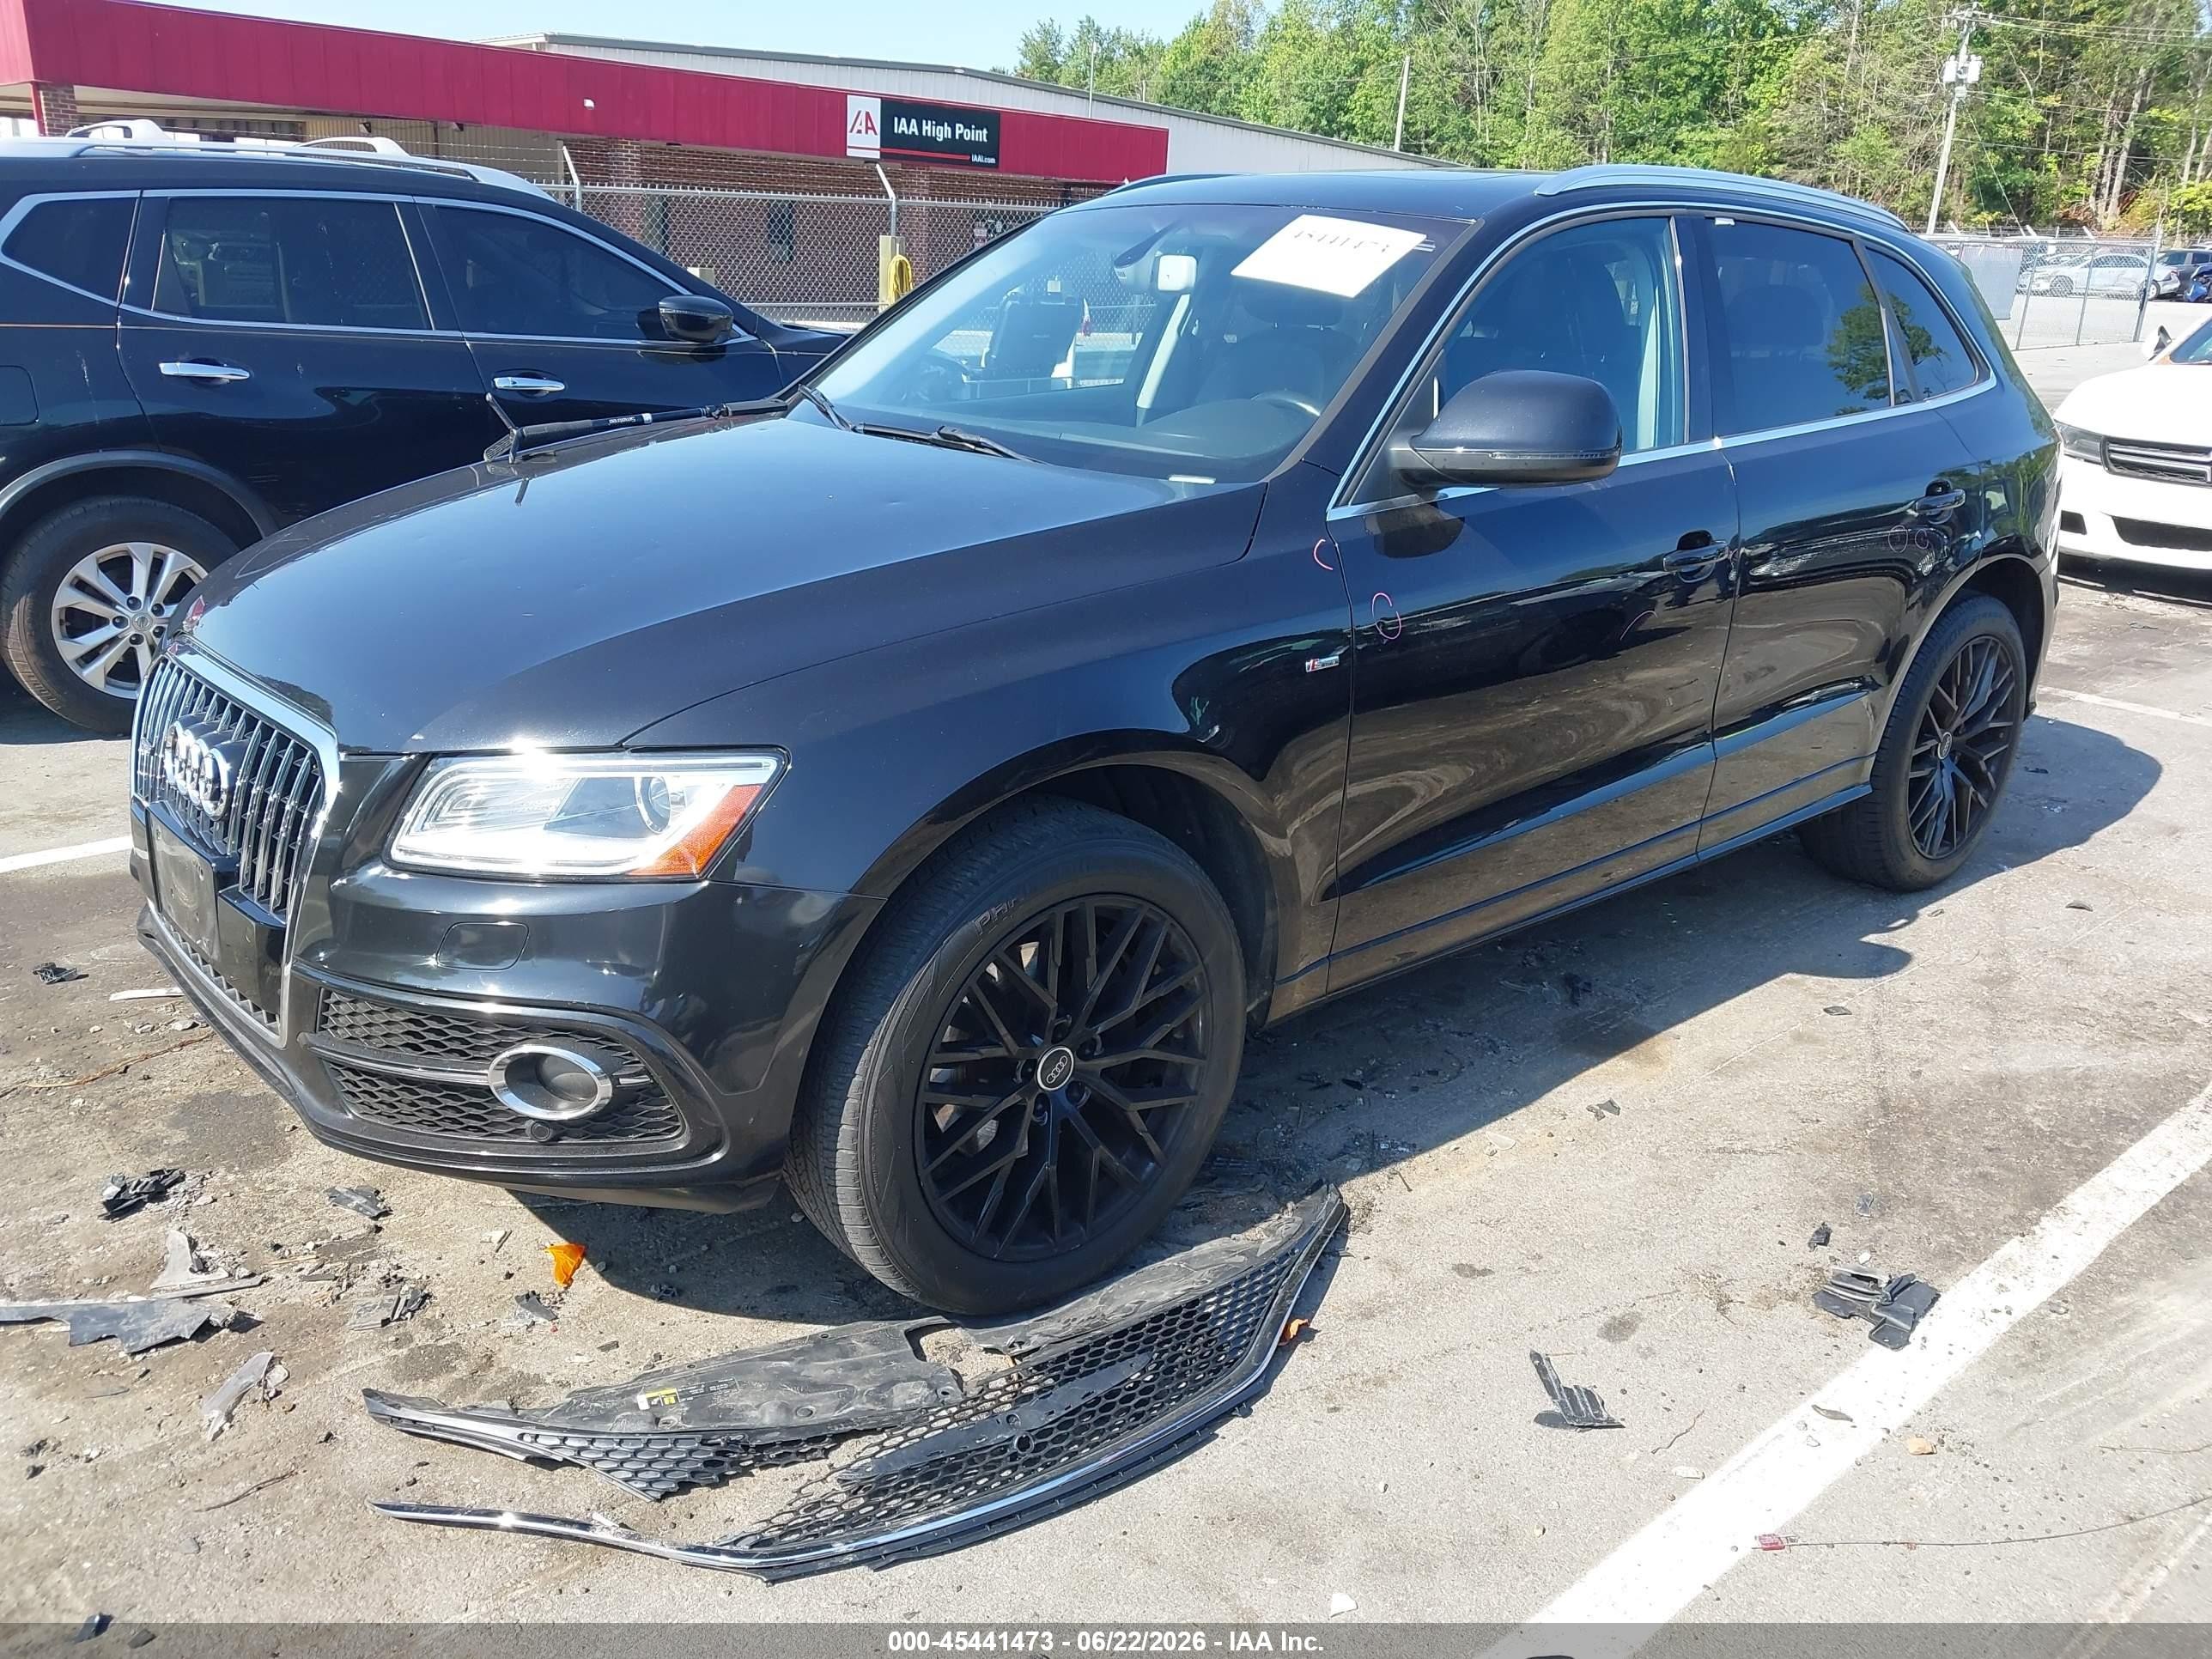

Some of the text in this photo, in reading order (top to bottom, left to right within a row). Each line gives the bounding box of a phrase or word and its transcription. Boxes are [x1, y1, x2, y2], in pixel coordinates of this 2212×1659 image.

[894, 116, 988, 143] IAA High Point
